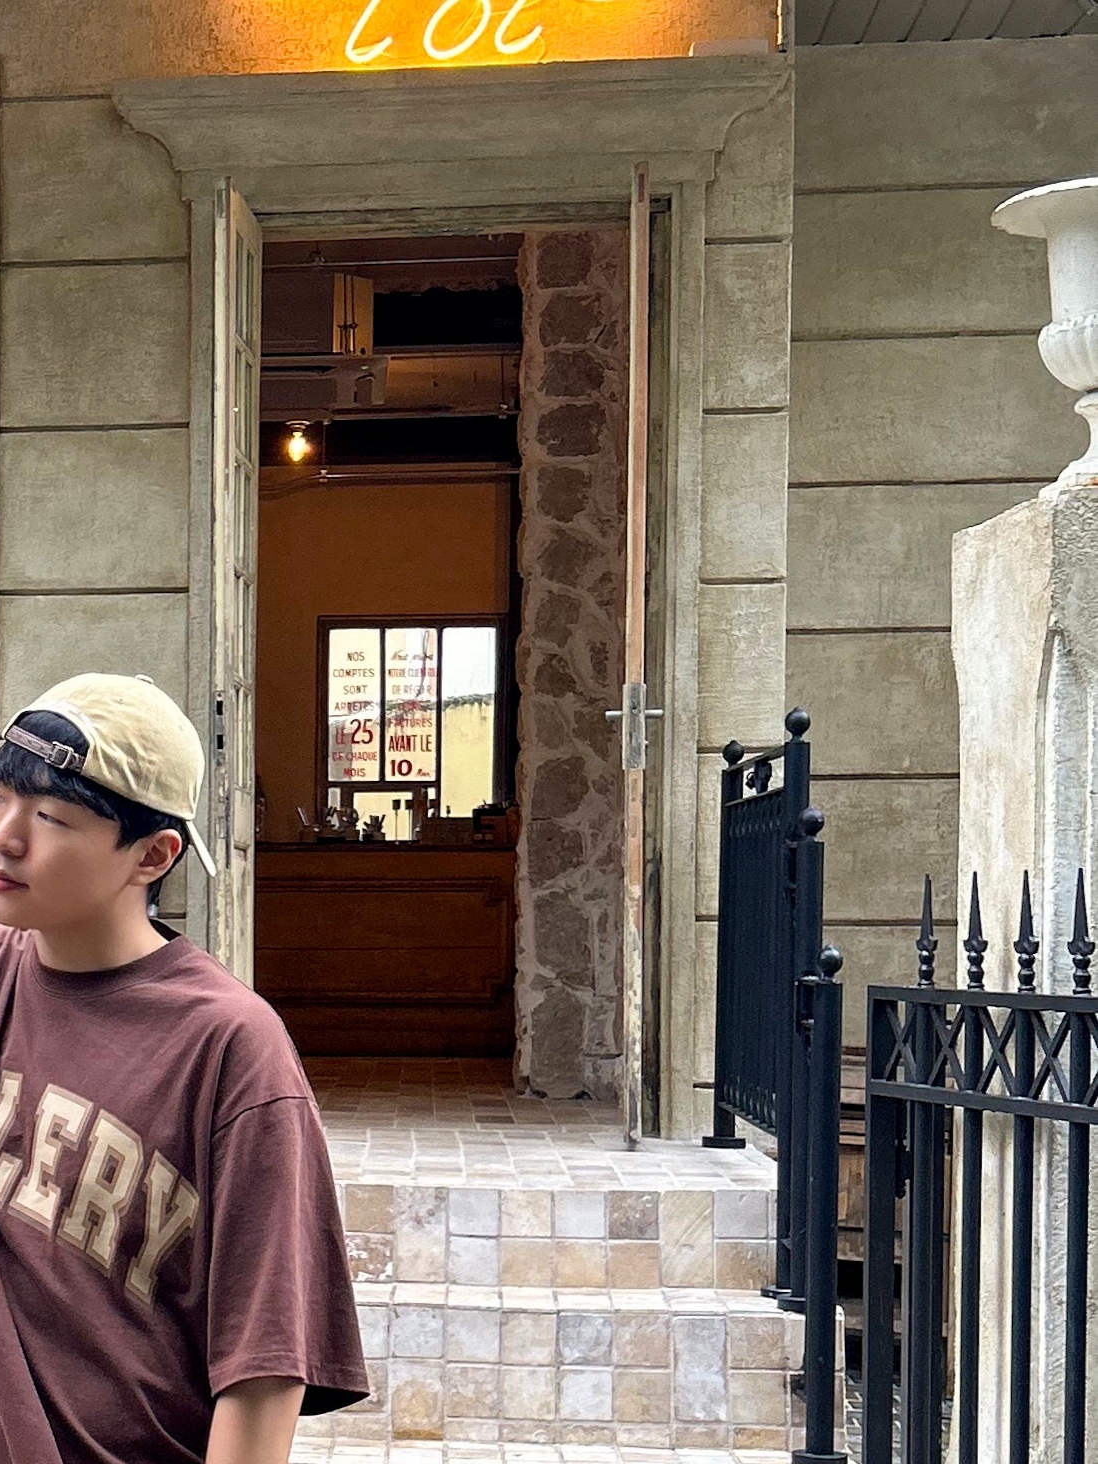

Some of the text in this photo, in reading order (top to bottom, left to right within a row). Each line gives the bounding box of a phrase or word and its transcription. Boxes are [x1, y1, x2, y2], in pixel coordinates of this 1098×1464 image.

[347, 652, 365, 661] NOS
[333, 669, 375, 678] COMPTES
[343, 685, 367, 694] SONT
[336, 719, 373, 745] LE 25
[388, 735, 432, 752] AVANT LE
[346, 752, 377, 761] CHAQUE
[390, 759, 412, 776] 10
